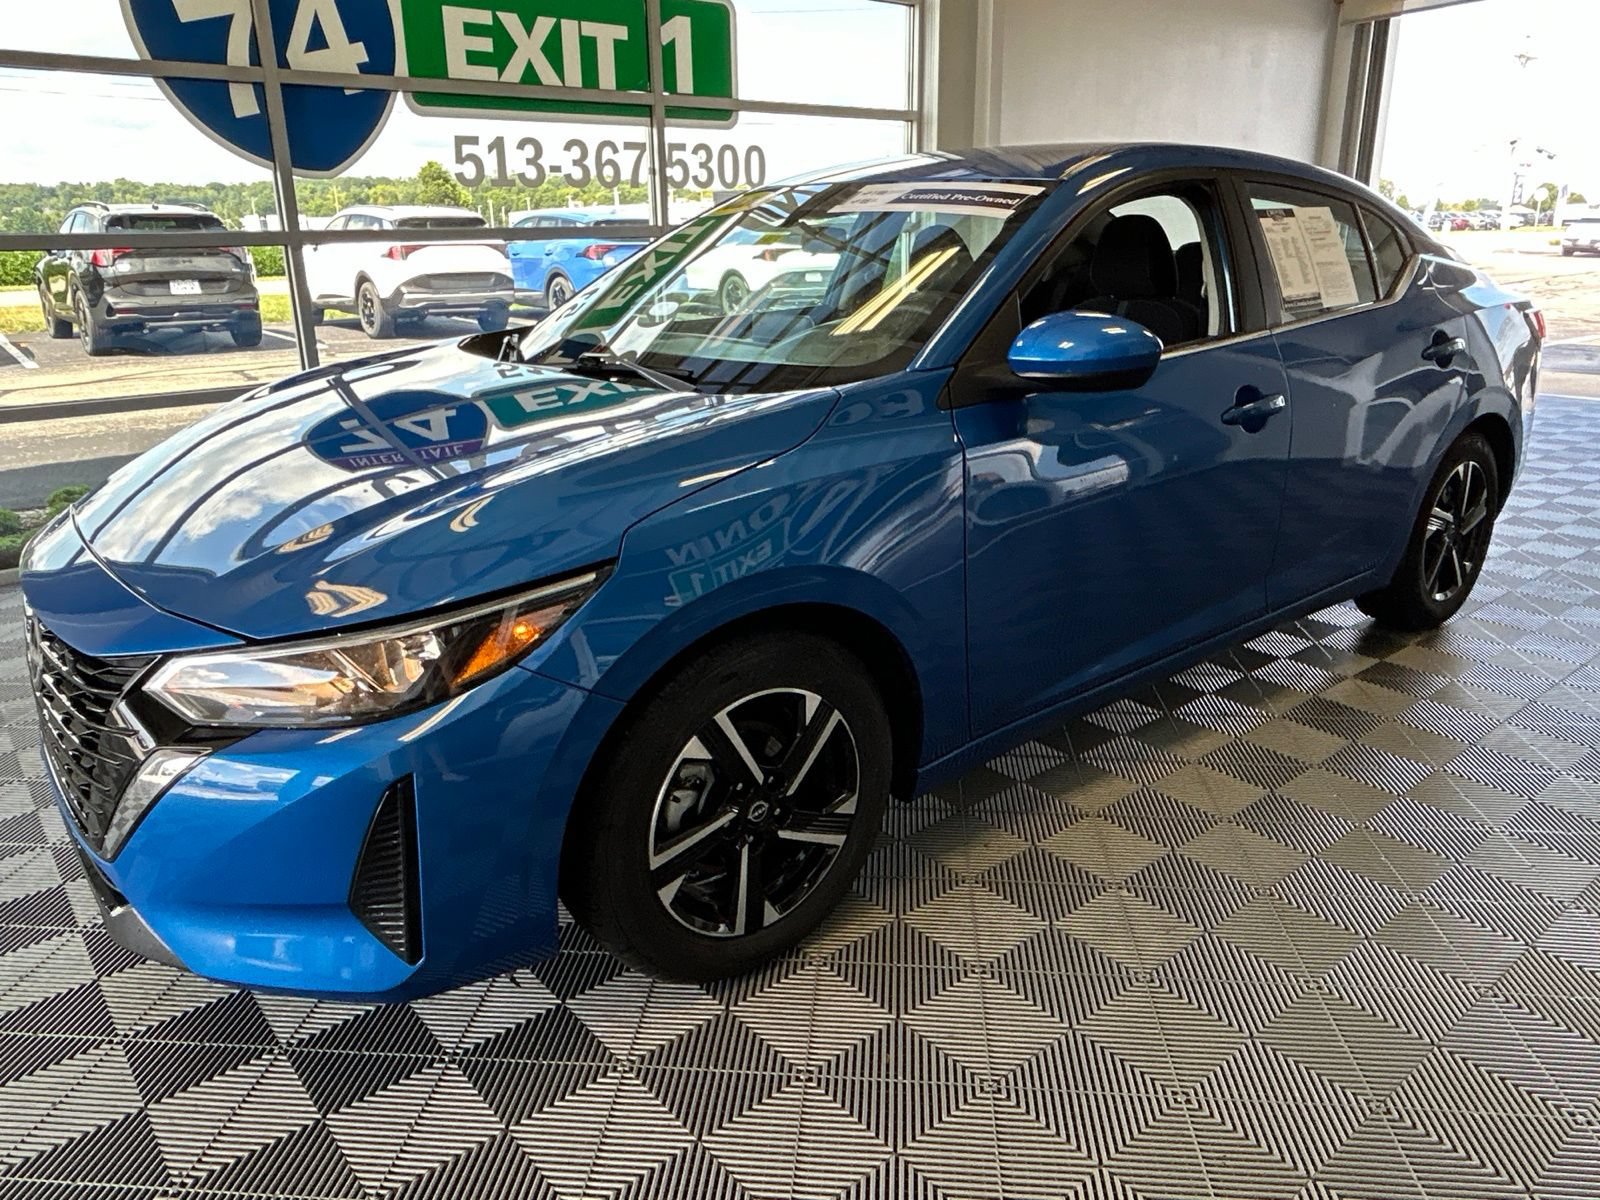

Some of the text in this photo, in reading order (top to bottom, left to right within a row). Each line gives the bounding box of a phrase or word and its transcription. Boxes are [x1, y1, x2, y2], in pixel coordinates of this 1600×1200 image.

[171, 0, 370, 118] 74
[440, 4, 695, 95] EXIT 1
[900, 191, 951, 201] Certified
[950, 192, 1022, 206] Pre-Owned
